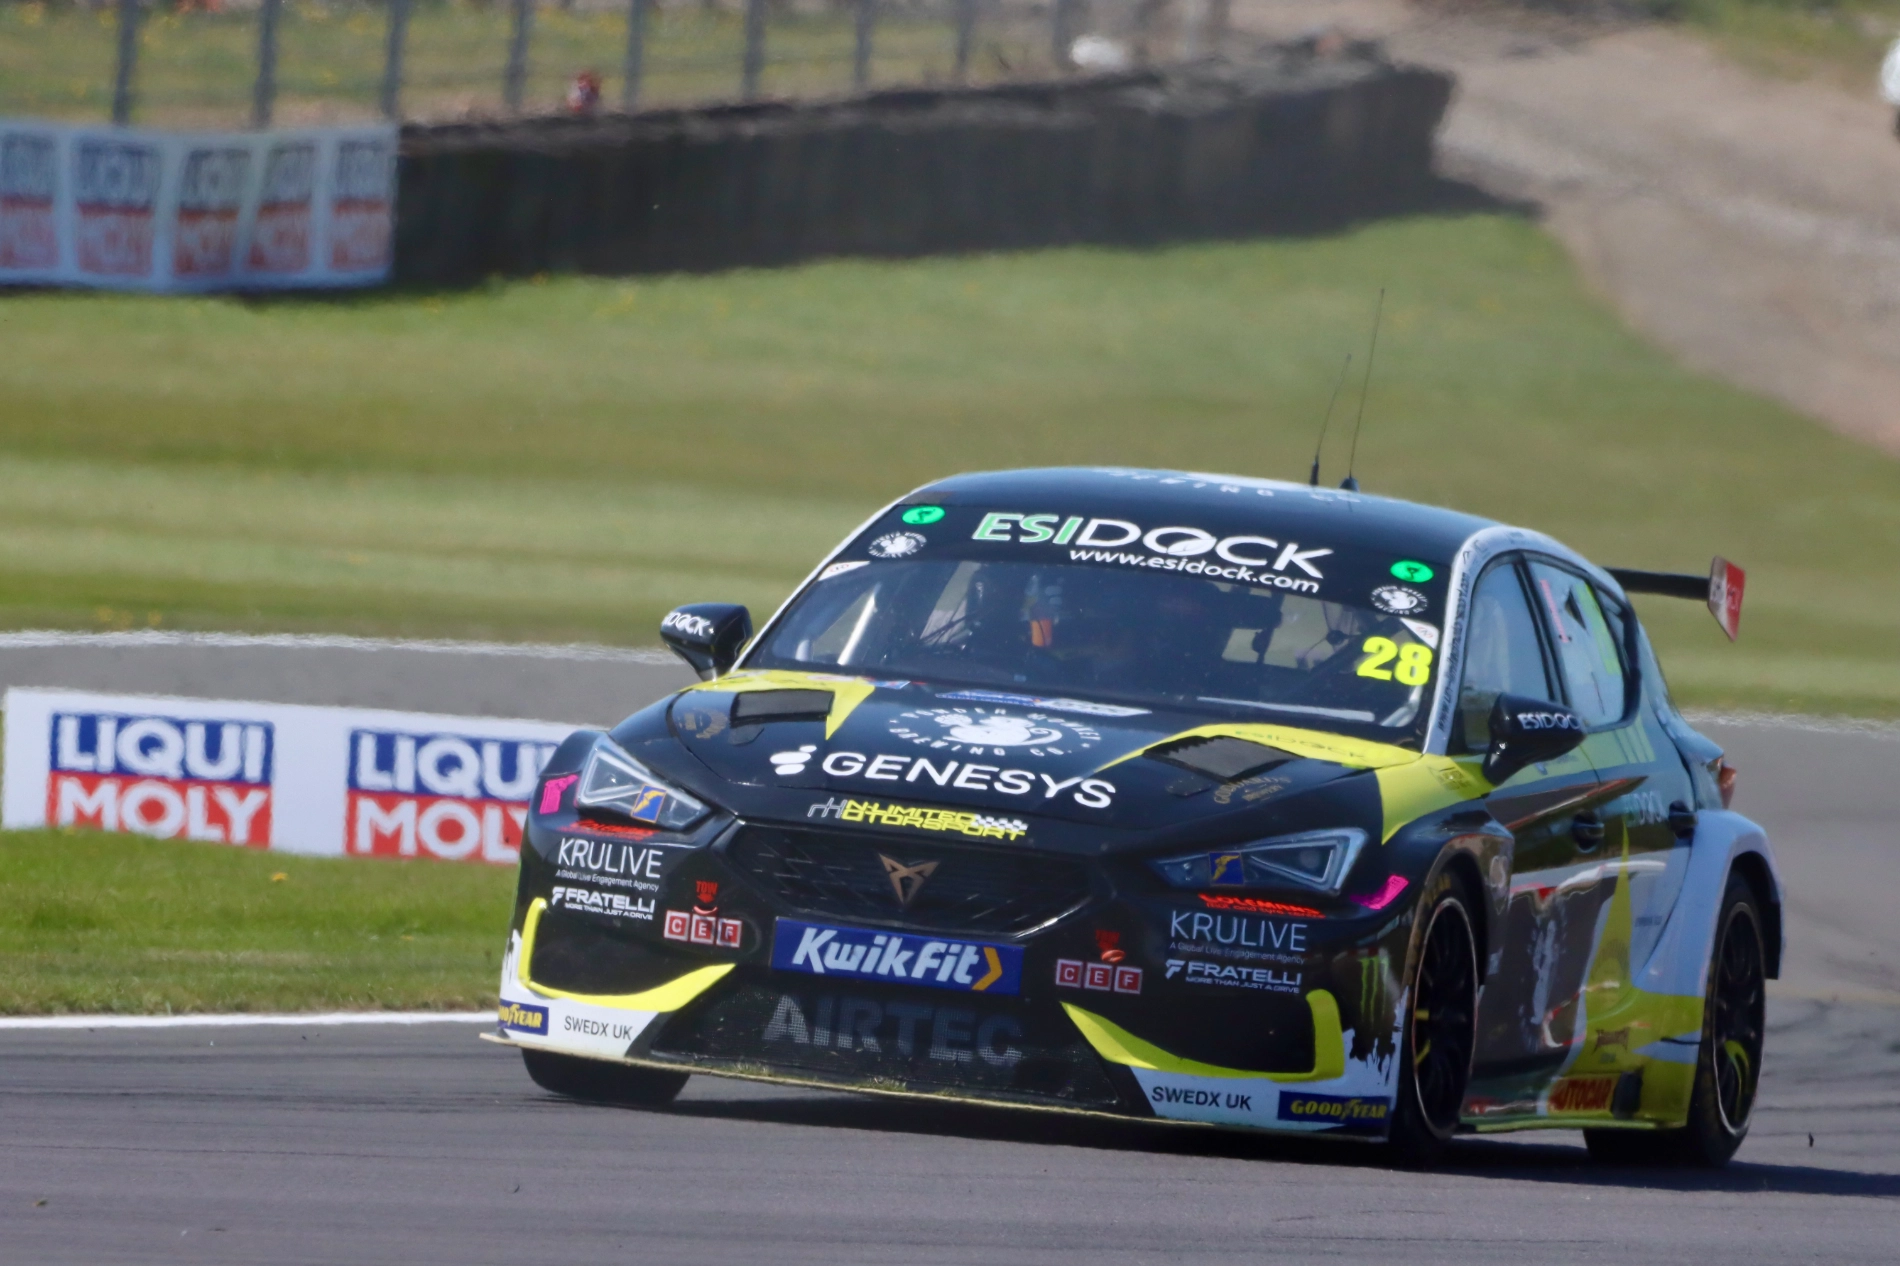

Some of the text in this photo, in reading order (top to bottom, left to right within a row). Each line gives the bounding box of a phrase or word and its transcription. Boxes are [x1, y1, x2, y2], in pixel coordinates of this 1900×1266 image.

[972, 511, 1334, 580] ESIDOCK
[1070, 550, 1320, 594] www.esidock.com
[1357, 635, 1434, 686] 28
[57, 714, 266, 783] LIQUI
[821, 751, 1116, 808] GENESYS
[57, 775, 268, 845] MOLY
[356, 797, 529, 861] MOL
[557, 837, 664, 879] KRULIVE
[592, 874, 632, 887] Engagement
[633, 880, 659, 892] Agency
[564, 902, 583, 911] MORE
[584, 904, 603, 914] THAN
[603, 908, 623, 917] JUST
[630, 911, 654, 921] DRIVE
[565, 887, 656, 914] FRATELLI
[669, 916, 737, 943] CEF
[1170, 910, 1308, 952] KRULIVE
[1178, 942, 1203, 952] Global
[1206, 946, 1222, 956] Live
[1224, 948, 1275, 962] Engagement
[1277, 953, 1306, 965] Agency
[1061, 964, 1138, 990] CEF
[1185, 976, 1213, 984] MORE
[1214, 978, 1240, 987] THAN
[1240, 981, 1263, 990] JUST
[1273, 984, 1300, 994] DRIVE
[1187, 960, 1303, 986] FRATELLI
[563, 1015, 633, 1041] SWEDX UK
[762, 994, 1024, 1068] AIRTEC
[1151, 1086, 1252, 1112] SWEDX UK
[1290, 1098, 1388, 1120] GOODYEAR
